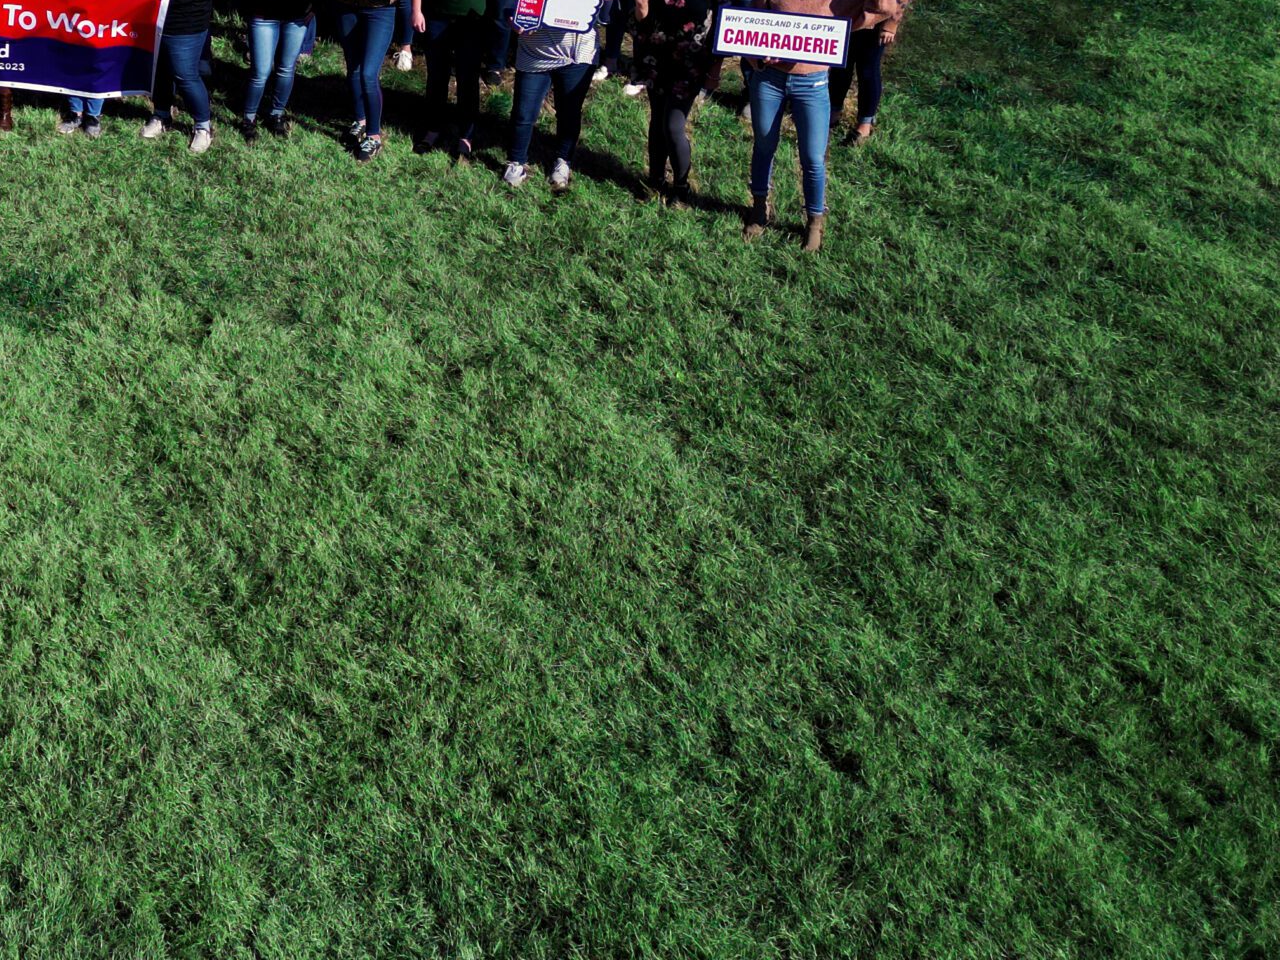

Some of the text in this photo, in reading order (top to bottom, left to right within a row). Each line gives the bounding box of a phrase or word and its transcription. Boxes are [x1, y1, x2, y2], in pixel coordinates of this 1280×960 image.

[2, 4, 37, 30] To
[744, 17, 791, 28] CROSSLAND
[723, 28, 839, 55] CAMARADERIE
